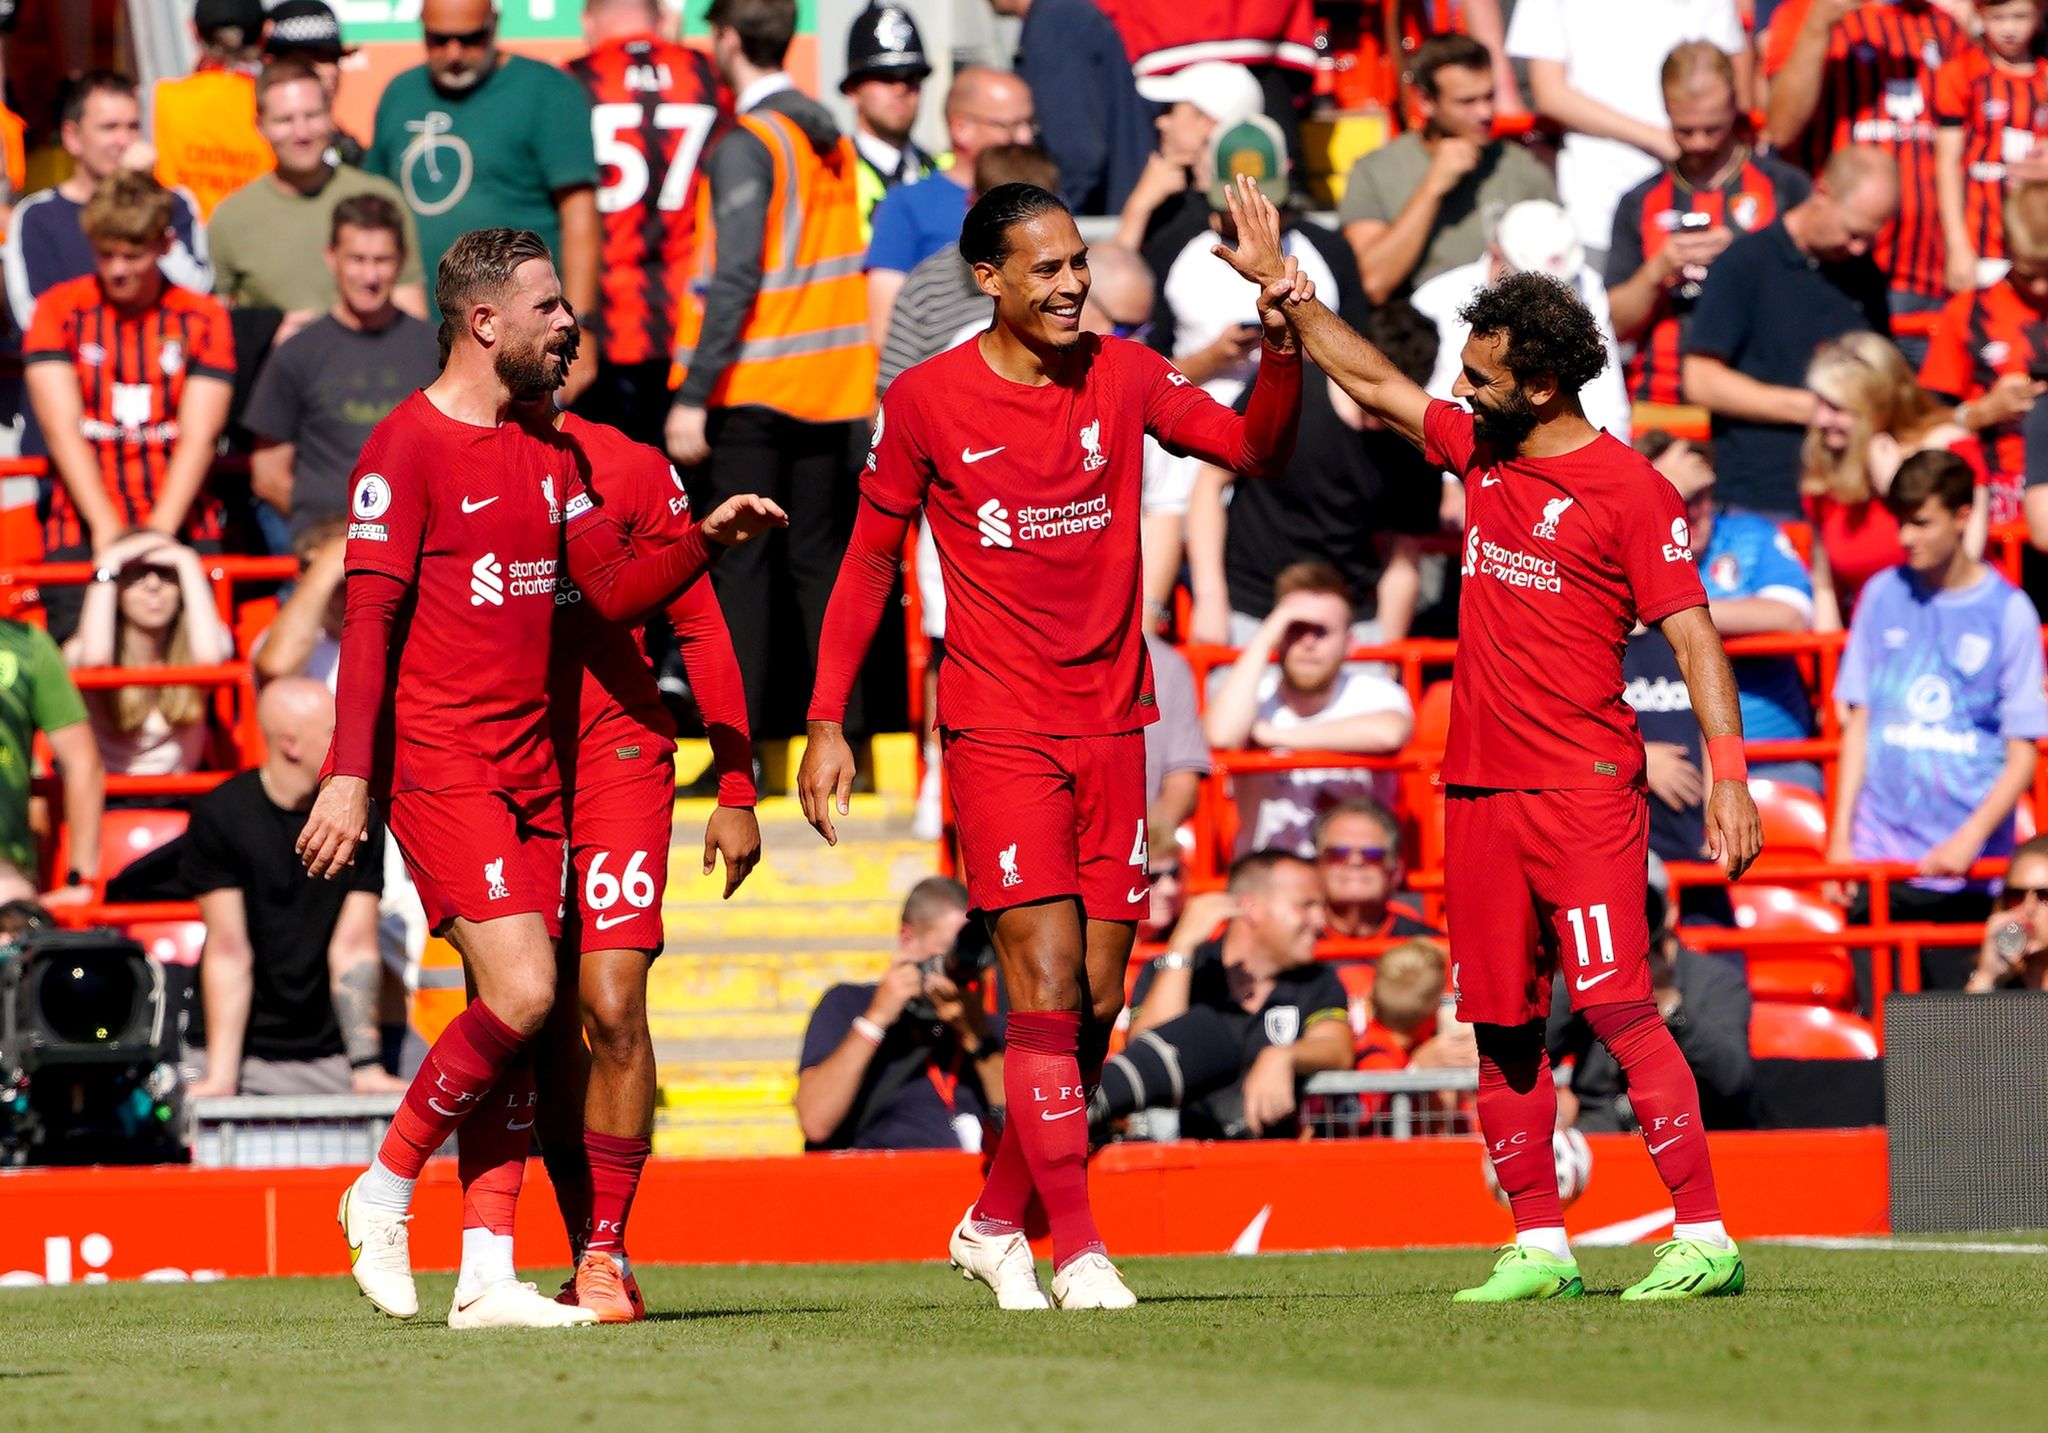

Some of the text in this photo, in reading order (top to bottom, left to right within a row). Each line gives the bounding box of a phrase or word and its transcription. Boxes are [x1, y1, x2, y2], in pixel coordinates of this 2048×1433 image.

[590, 103, 718, 213] 57
[1017, 493, 1107, 524] standard
[1018, 509, 1113, 541] chartered
[508, 557, 558, 579] standar
[1481, 541, 1557, 577] standard
[509, 577, 557, 596] charter
[1128, 819, 1148, 875] 4
[585, 850, 655, 910] 66
[1567, 903, 1615, 967] 11
